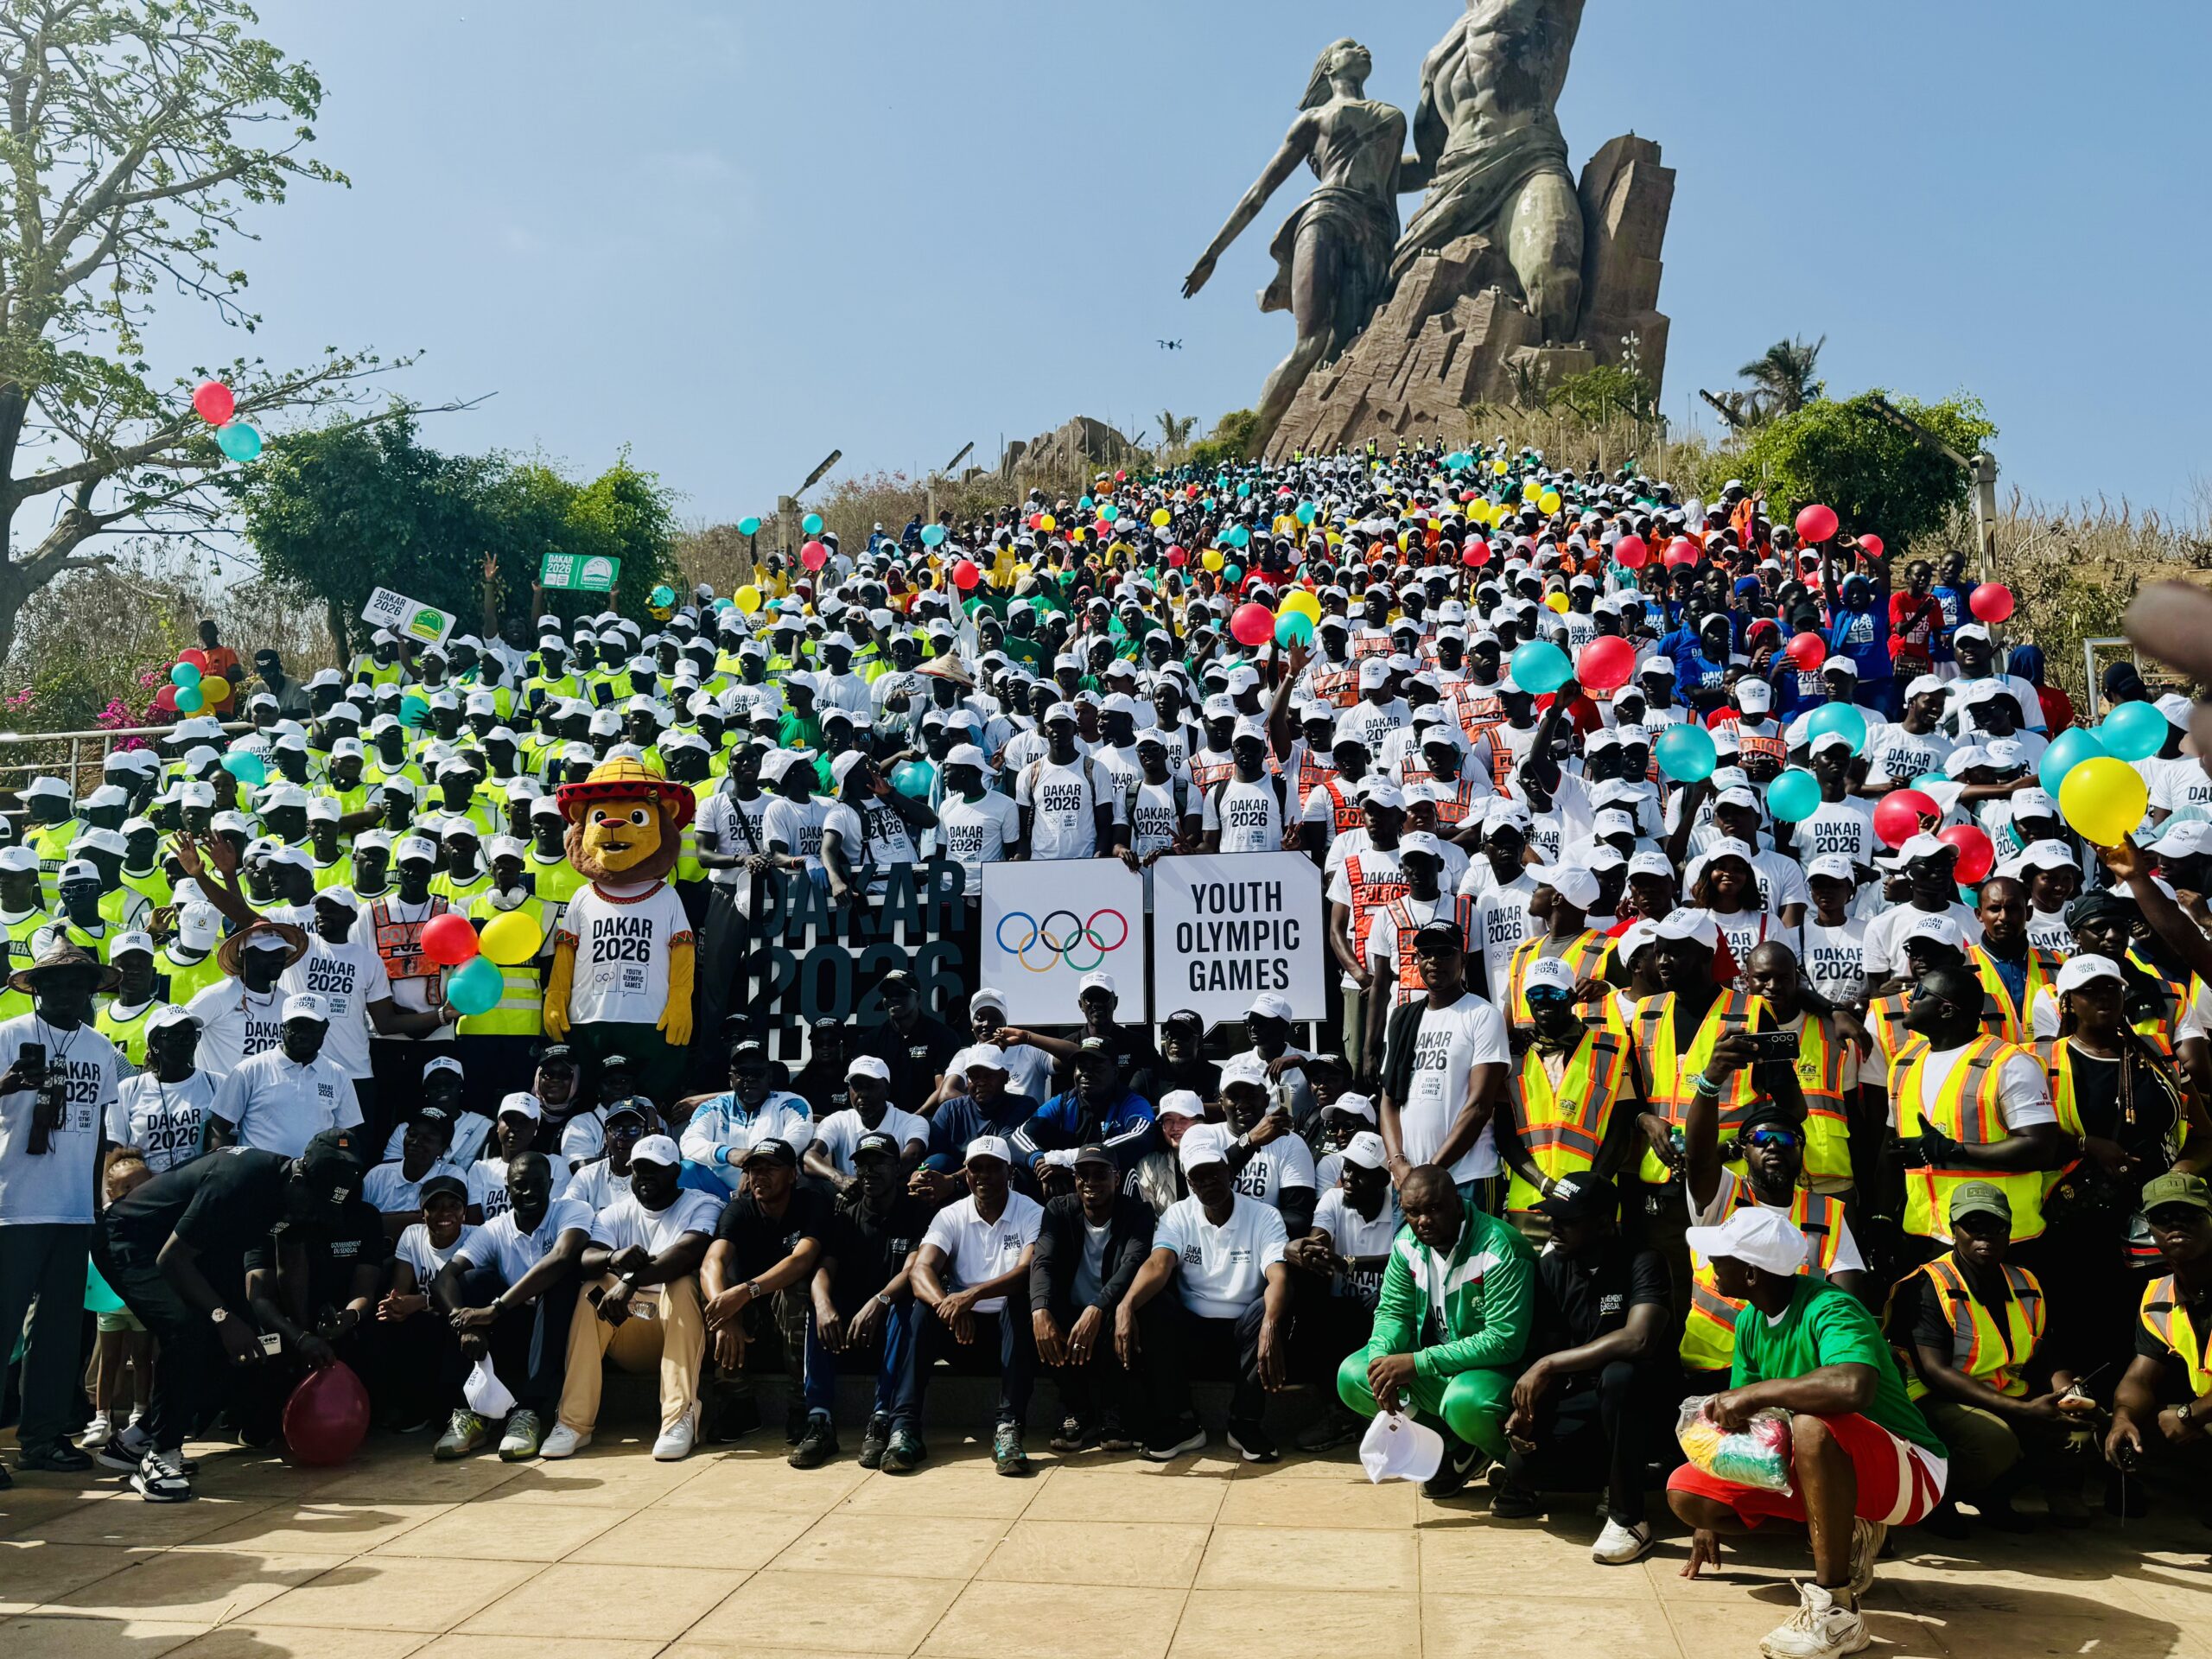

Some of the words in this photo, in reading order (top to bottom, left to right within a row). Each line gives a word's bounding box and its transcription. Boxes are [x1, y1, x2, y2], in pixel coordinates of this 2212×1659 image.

[548, 555, 574, 564] DAKAR
[547, 563, 571, 574] 2026
[378, 590, 407, 607] DAKAR
[373, 599, 402, 616] 2026
[734, 695, 760, 704] DAKAR
[1365, 716, 1401, 729] DAKAR
[1738, 740, 1785, 755] POLICE
[1887, 748, 1931, 767] DAKAR
[1110, 773, 1131, 785] AKAR
[1044, 785, 1081, 797] DAKAR
[1045, 797, 1080, 811] 2026
[1230, 800, 1268, 811] DAKAR
[1136, 808, 1170, 821] DAKAR
[1231, 812, 1268, 827] 2026
[799, 827, 823, 840] DAKA
[950, 826, 983, 838] DAKAR
[1138, 822, 1170, 836] 2026
[1815, 823, 1860, 836] DAKAR
[801, 842, 822, 855] 202
[950, 838, 982, 852] 2026
[1815, 837, 1859, 854] 2026
[750, 860, 966, 938] DAKAR
[1191, 881, 1282, 914] YOUTH
[1487, 906, 1521, 925] DAKAR
[593, 917, 652, 939] DAKAR
[1489, 922, 1522, 944] 2026
[1916, 921, 1941, 930] 2026
[1176, 919, 1300, 955] OLYMPIC
[2031, 931, 2072, 946] DAKA
[593, 938, 651, 963] 2026
[309, 957, 355, 977] DAKAR
[1189, 958, 1289, 992] GAMES
[1535, 966, 1558, 975] 2026
[1815, 963, 1865, 981] 2026
[308, 975, 353, 994] 2026
[622, 975, 645, 983] OLYMPIC
[748, 940, 964, 1027] 2026
[1416, 1031, 1453, 1049] AKAR
[1412, 1049, 1447, 1071] 026
[65, 1081, 98, 1103] 026
[147, 1109, 200, 1130] DAKAR
[149, 1127, 200, 1150] 2026
[1231, 1178, 1267, 1198] 026
